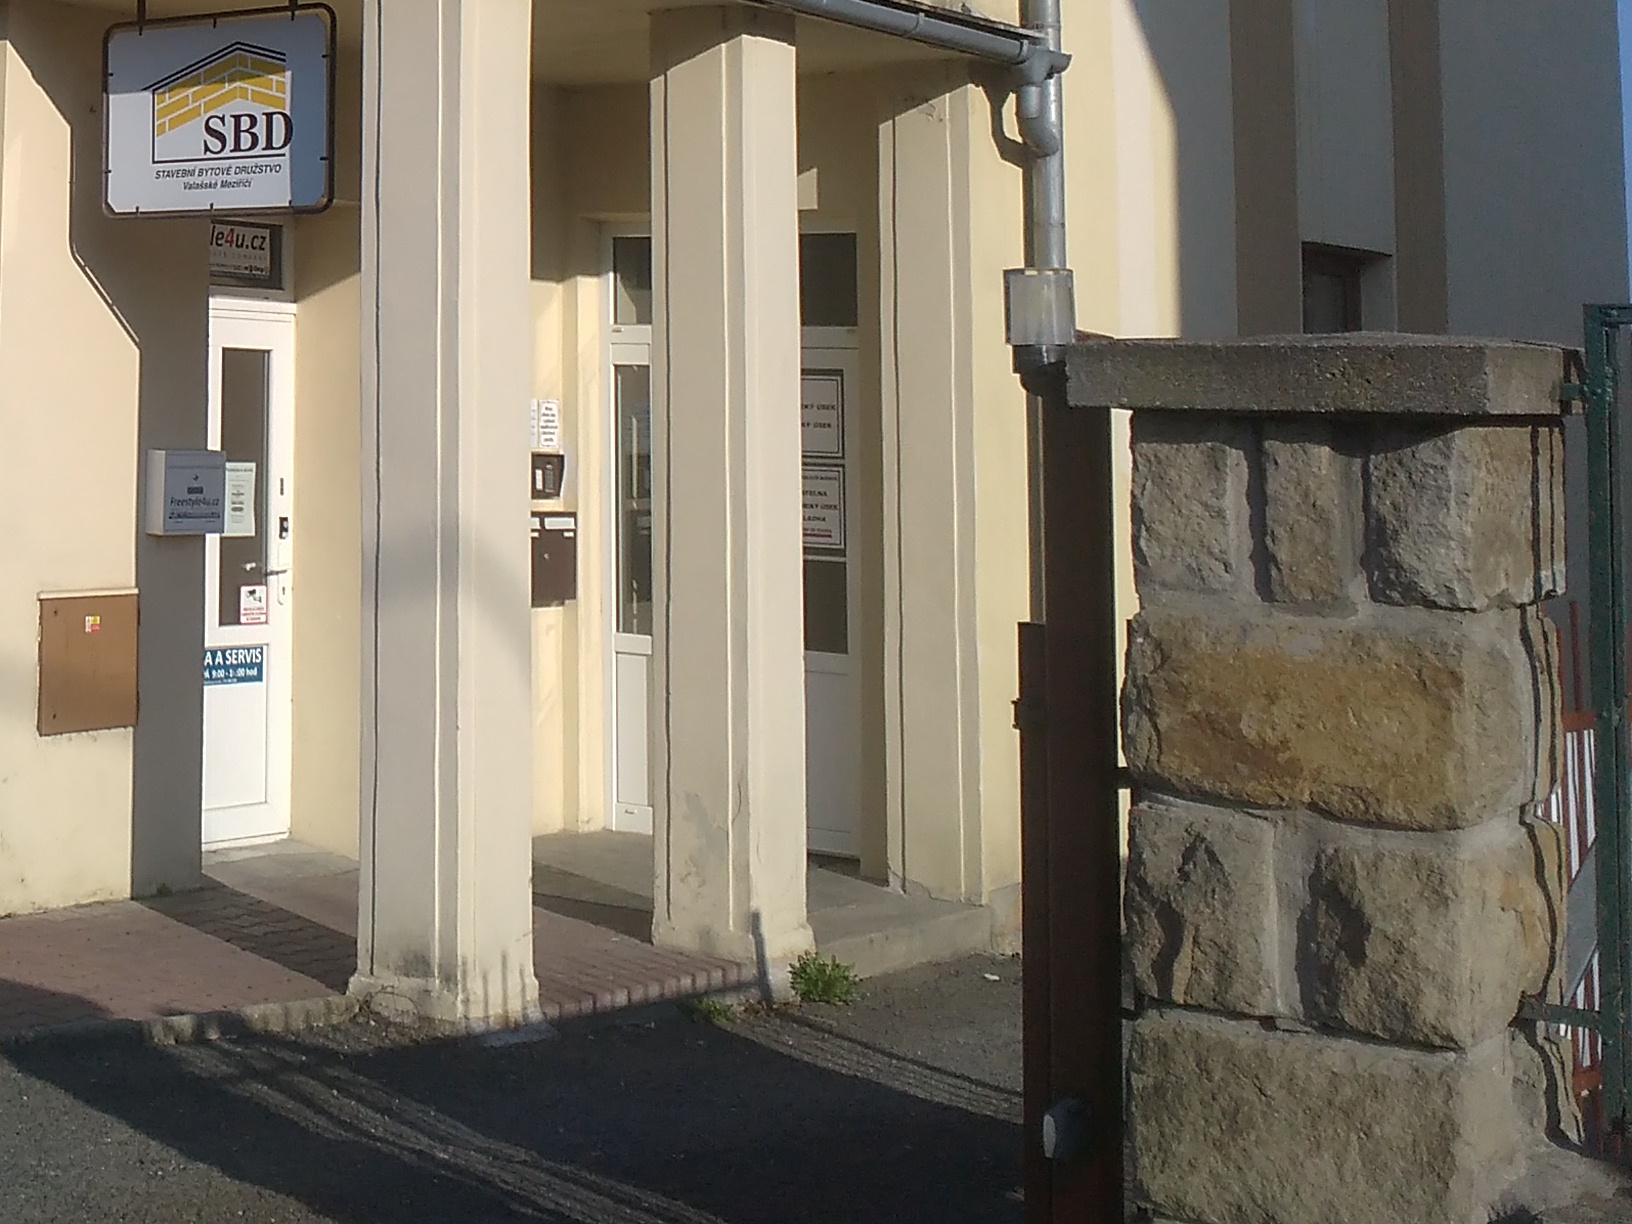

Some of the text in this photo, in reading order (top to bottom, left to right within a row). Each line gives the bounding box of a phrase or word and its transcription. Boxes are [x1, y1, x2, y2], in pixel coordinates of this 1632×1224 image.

[203, 111, 294, 156] SBD
[155, 163, 282, 179] STAVEBNÍ BYTOVÉ DRUŽSTVO
[183, 181, 218, 190] Valašské
[210, 225, 267, 251] le4u.cz
[215, 650, 224, 665] A
[225, 647, 262, 665] SERVIS
